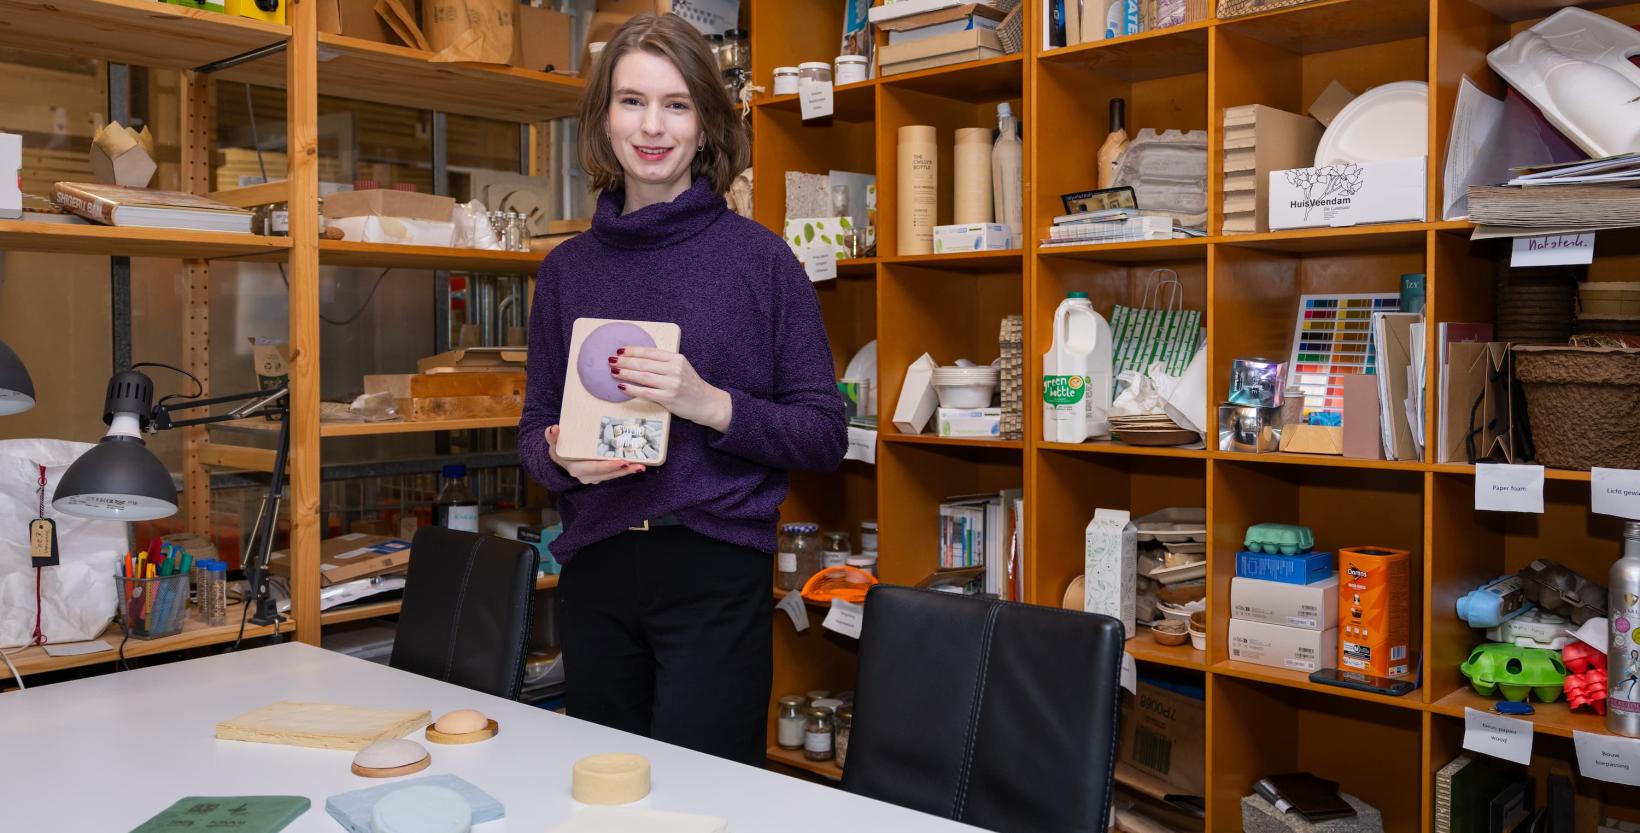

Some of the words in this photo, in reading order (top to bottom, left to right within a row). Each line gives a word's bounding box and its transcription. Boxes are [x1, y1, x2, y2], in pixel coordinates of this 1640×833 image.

[1290, 197, 1351, 208] HuisVeendam
[1050, 385, 1076, 397] bottle
[1492, 484, 1510, 492] Paper
[1606, 487, 1622, 495] Licht
[1347, 568, 1367, 578] Doritos
